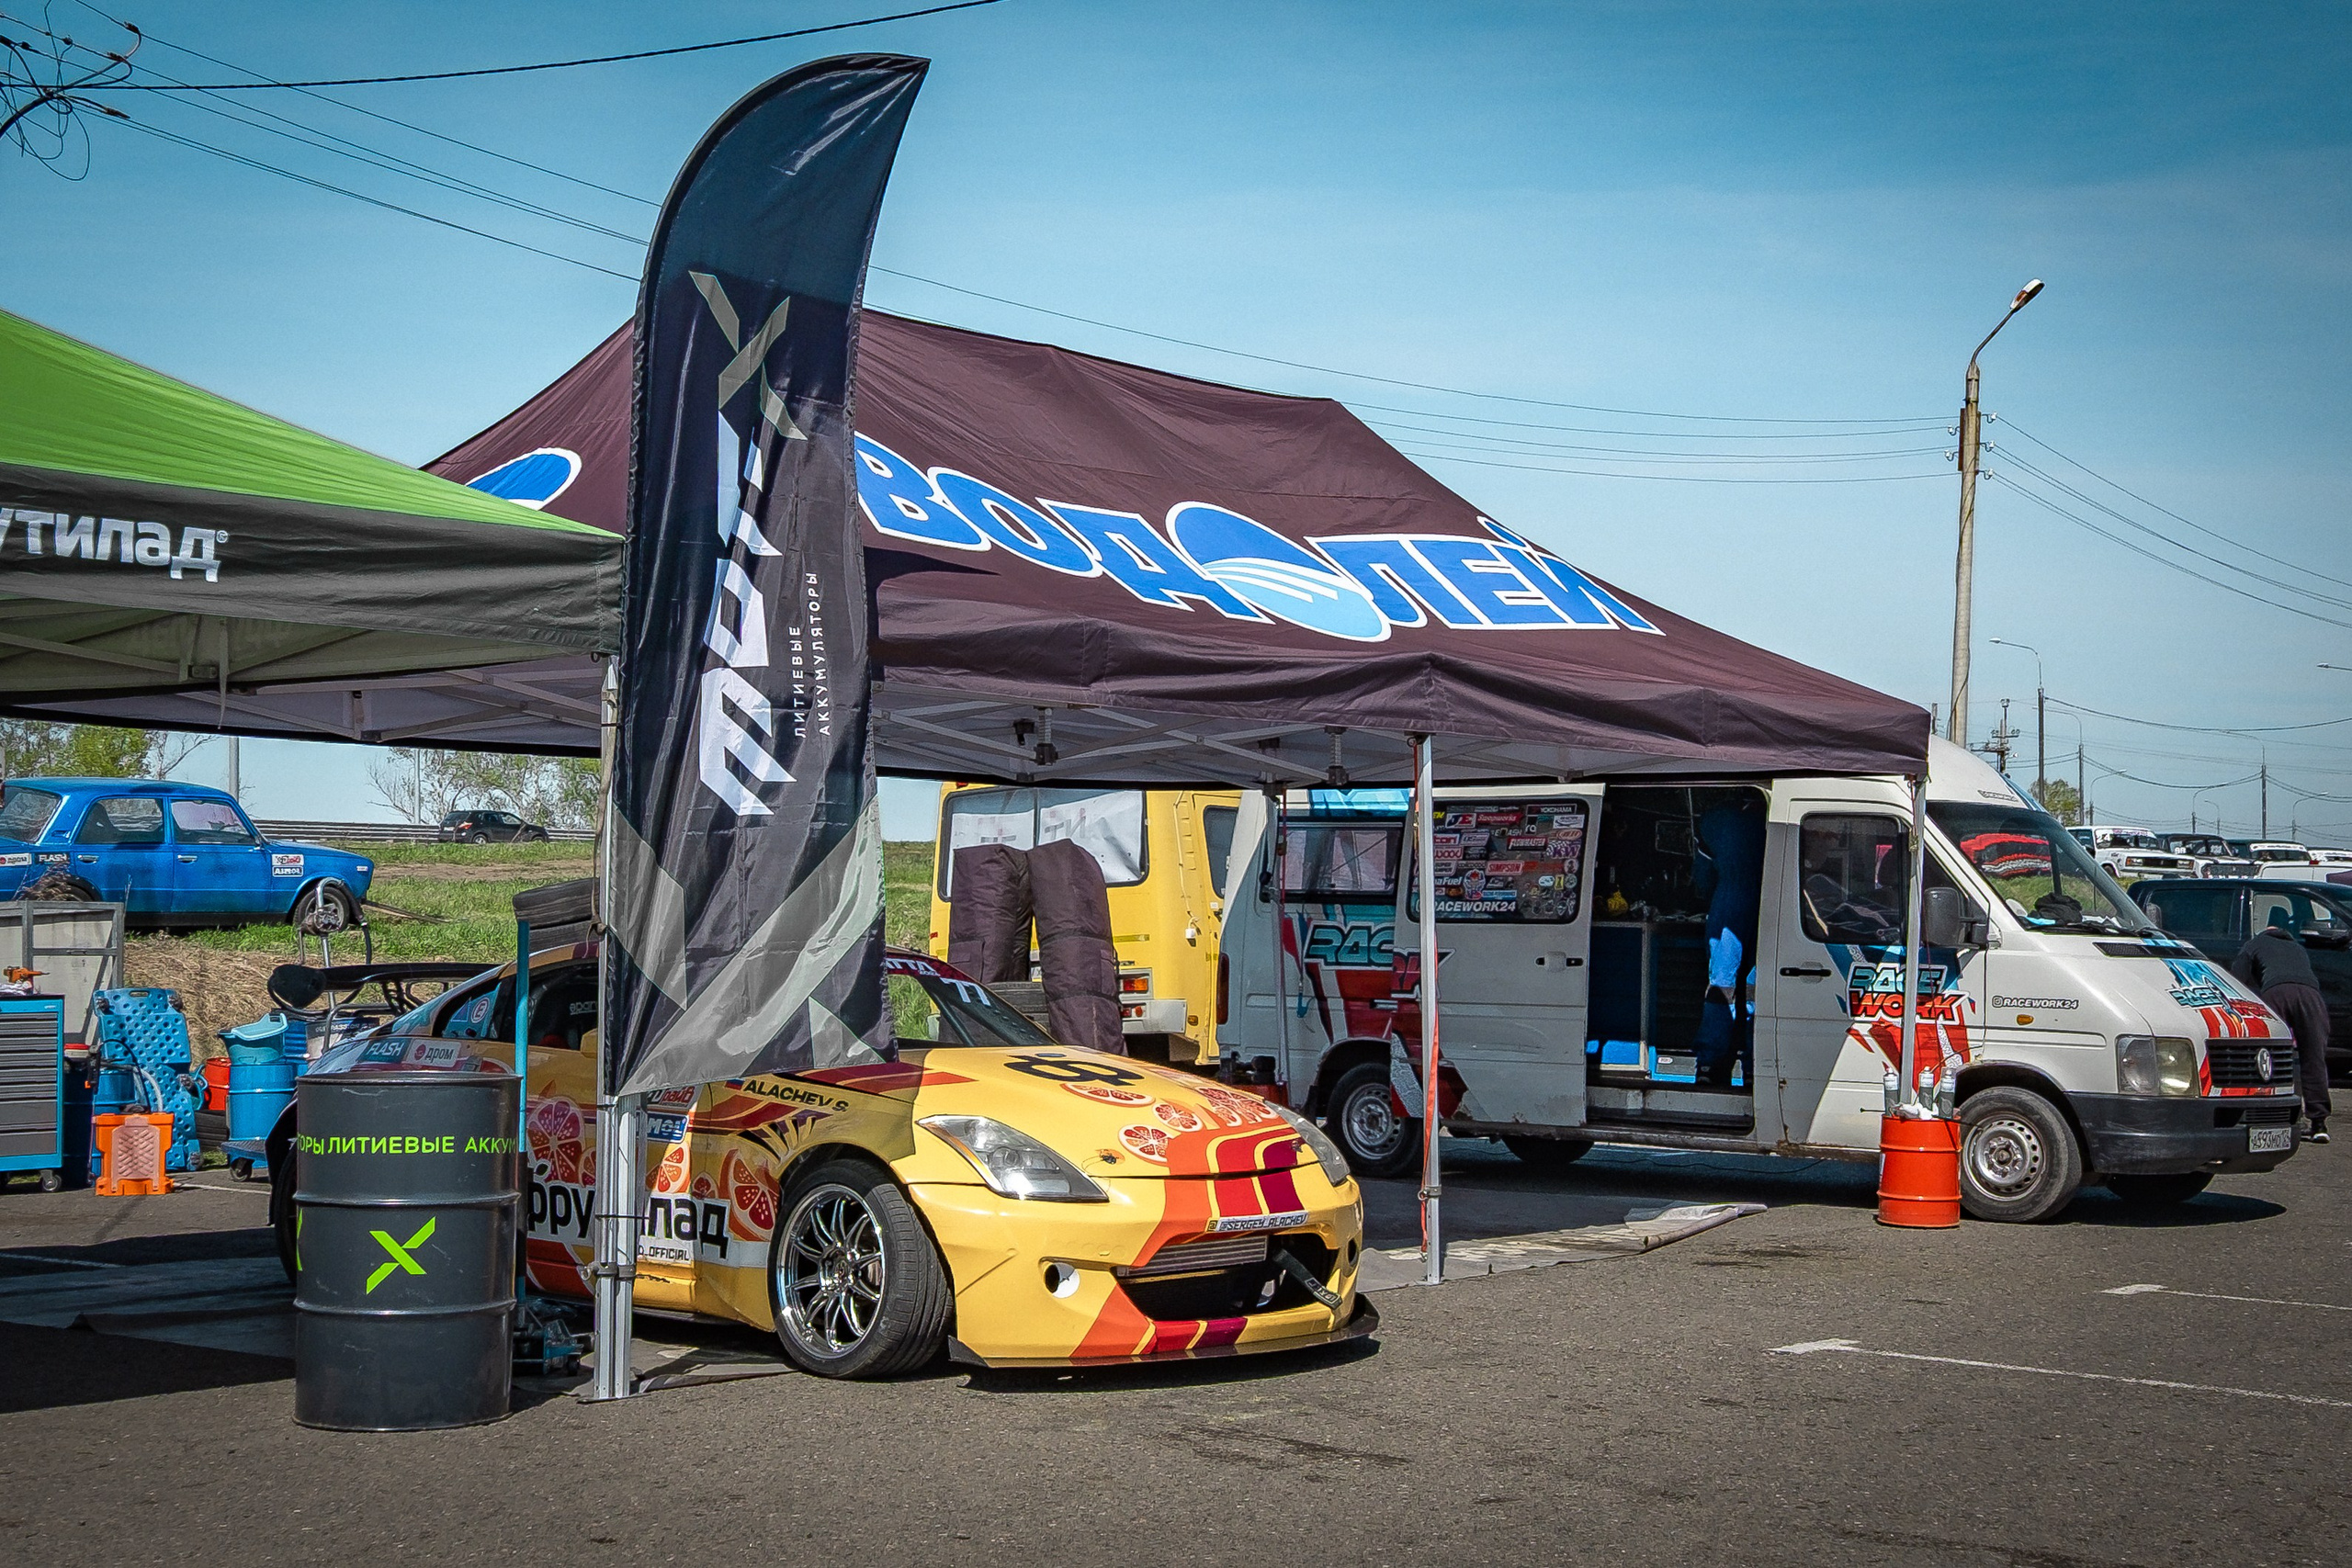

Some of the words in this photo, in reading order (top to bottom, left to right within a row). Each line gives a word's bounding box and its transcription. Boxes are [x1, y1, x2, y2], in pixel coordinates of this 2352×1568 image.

[805, 571, 831, 737] АККУМУЛЯТОРЫ
[789, 625, 808, 739] ЛИТИЕВЫЕ
[1487, 863, 1522, 872] SIMPSON
[939, 976, 990, 1006] 77
[2003, 998, 2079, 1010] RACEWORK24
[368, 1041, 404, 1056] FLASH
[425, 1045, 454, 1062] дром
[743, 1079, 834, 1108] ALACHEV
[327, 1136, 455, 1155] ЛИТИЕВЫЕ
